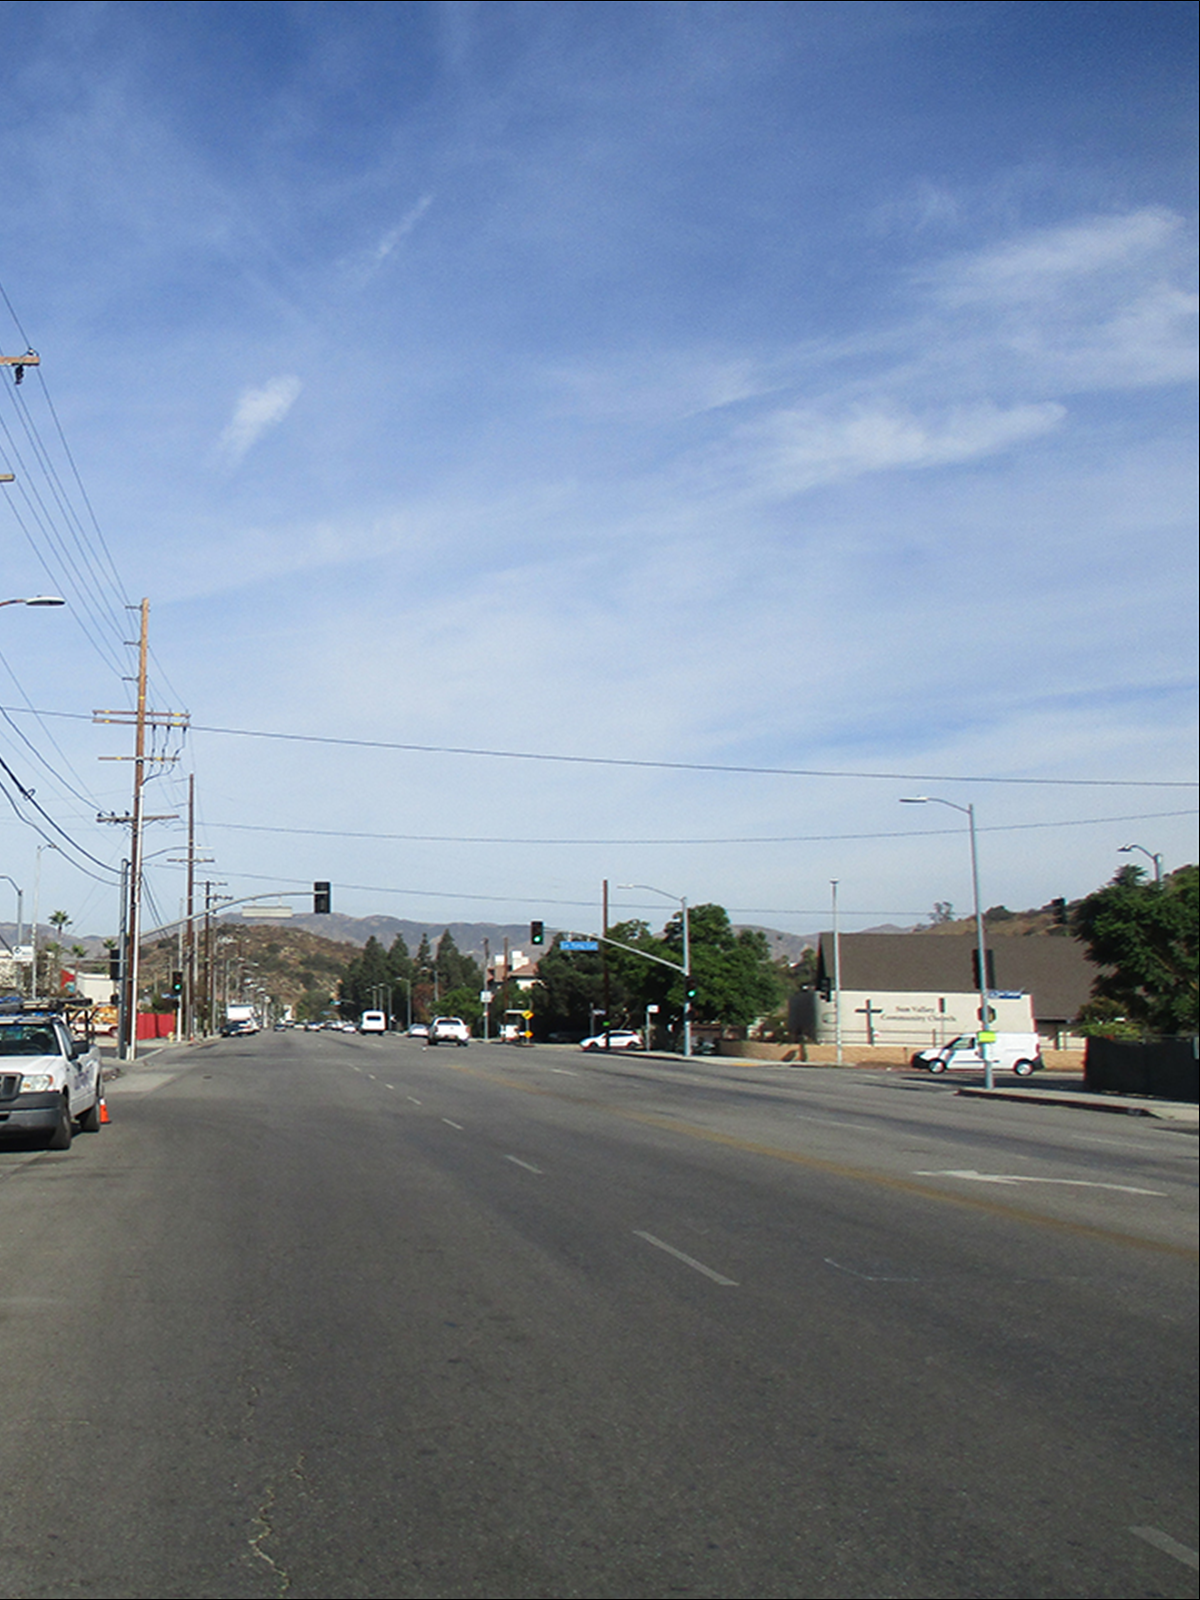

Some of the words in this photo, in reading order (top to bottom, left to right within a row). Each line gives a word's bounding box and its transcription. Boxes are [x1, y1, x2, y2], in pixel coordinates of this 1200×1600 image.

[911, 1005, 936, 1015] Valley
[880, 1014, 926, 1023] Community
[927, 1014, 957, 1022] Church
